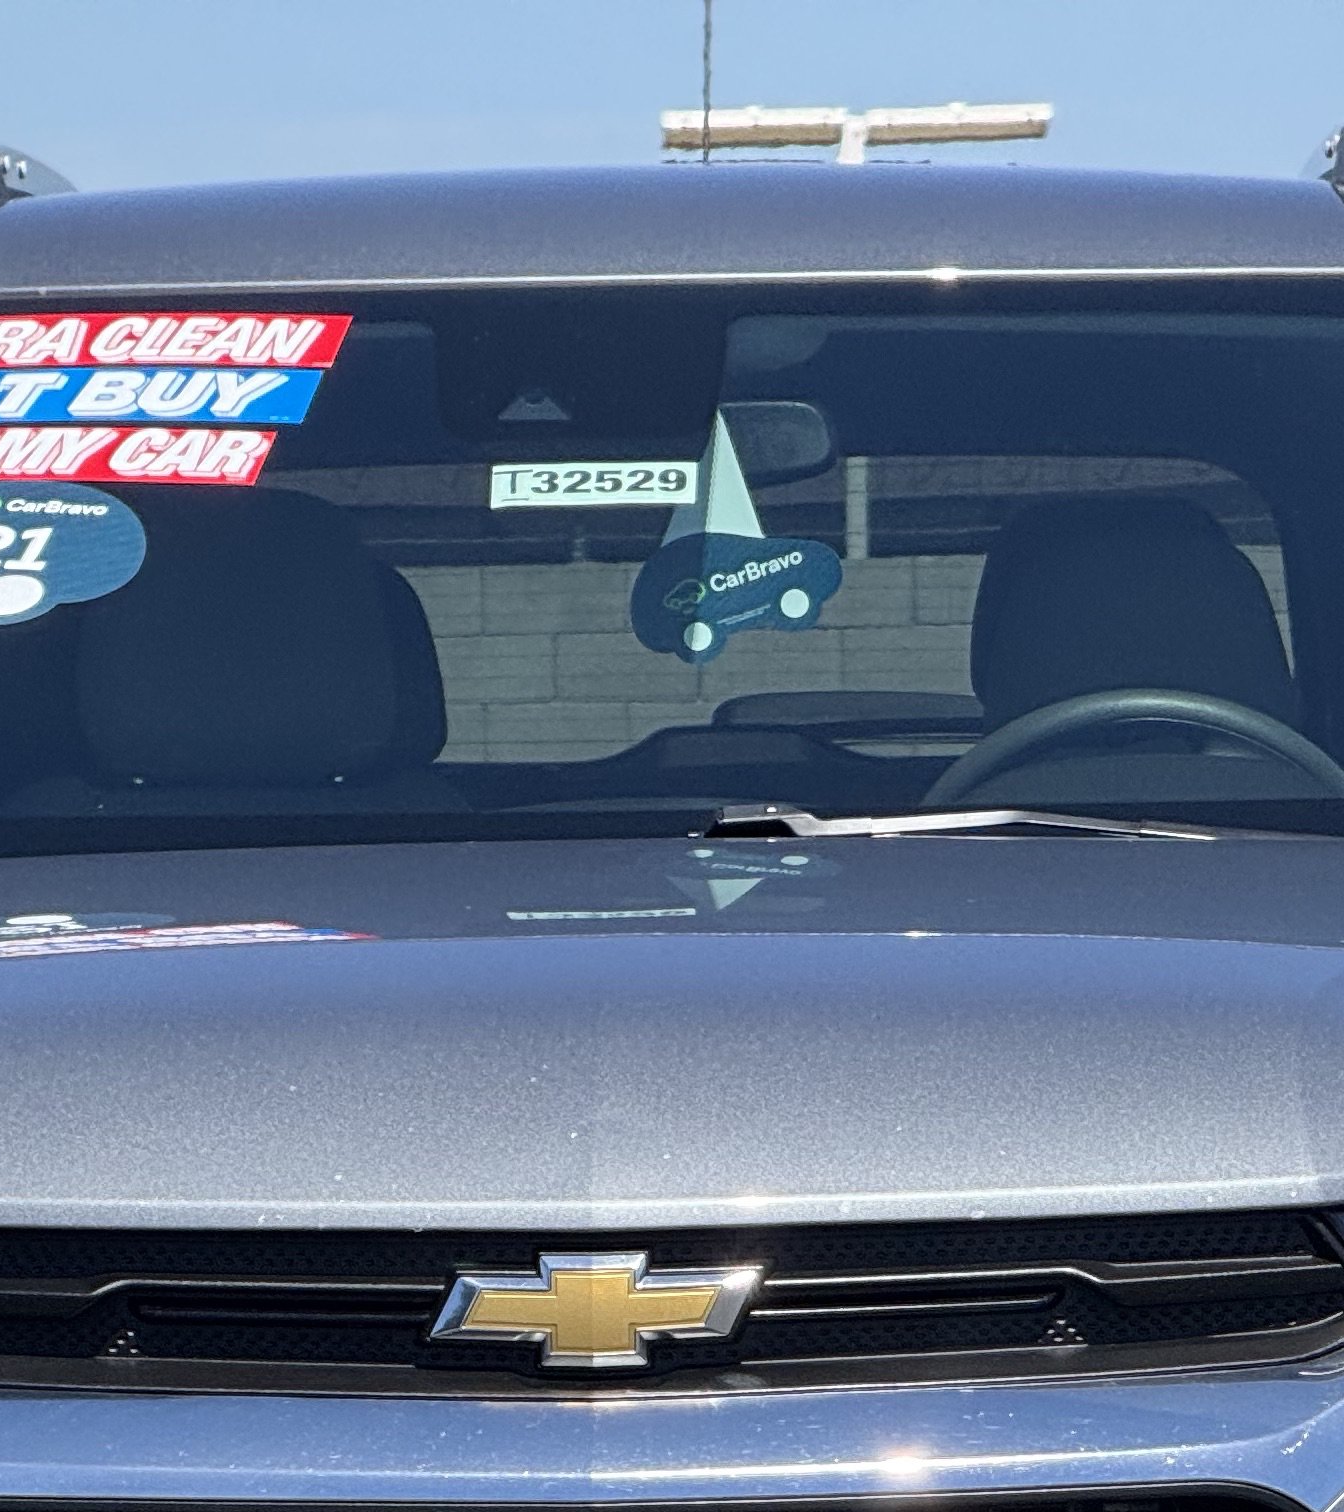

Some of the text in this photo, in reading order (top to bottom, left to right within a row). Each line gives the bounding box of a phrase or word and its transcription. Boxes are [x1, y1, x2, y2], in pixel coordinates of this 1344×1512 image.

[90, 316, 326, 363] CLEAN
[67, 369, 290, 417] BUY
[108, 428, 271, 481] CAR
[493, 468, 688, 501] T32529
[6, 499, 108, 516] CarBravo
[710, 551, 803, 592] CarBravo
